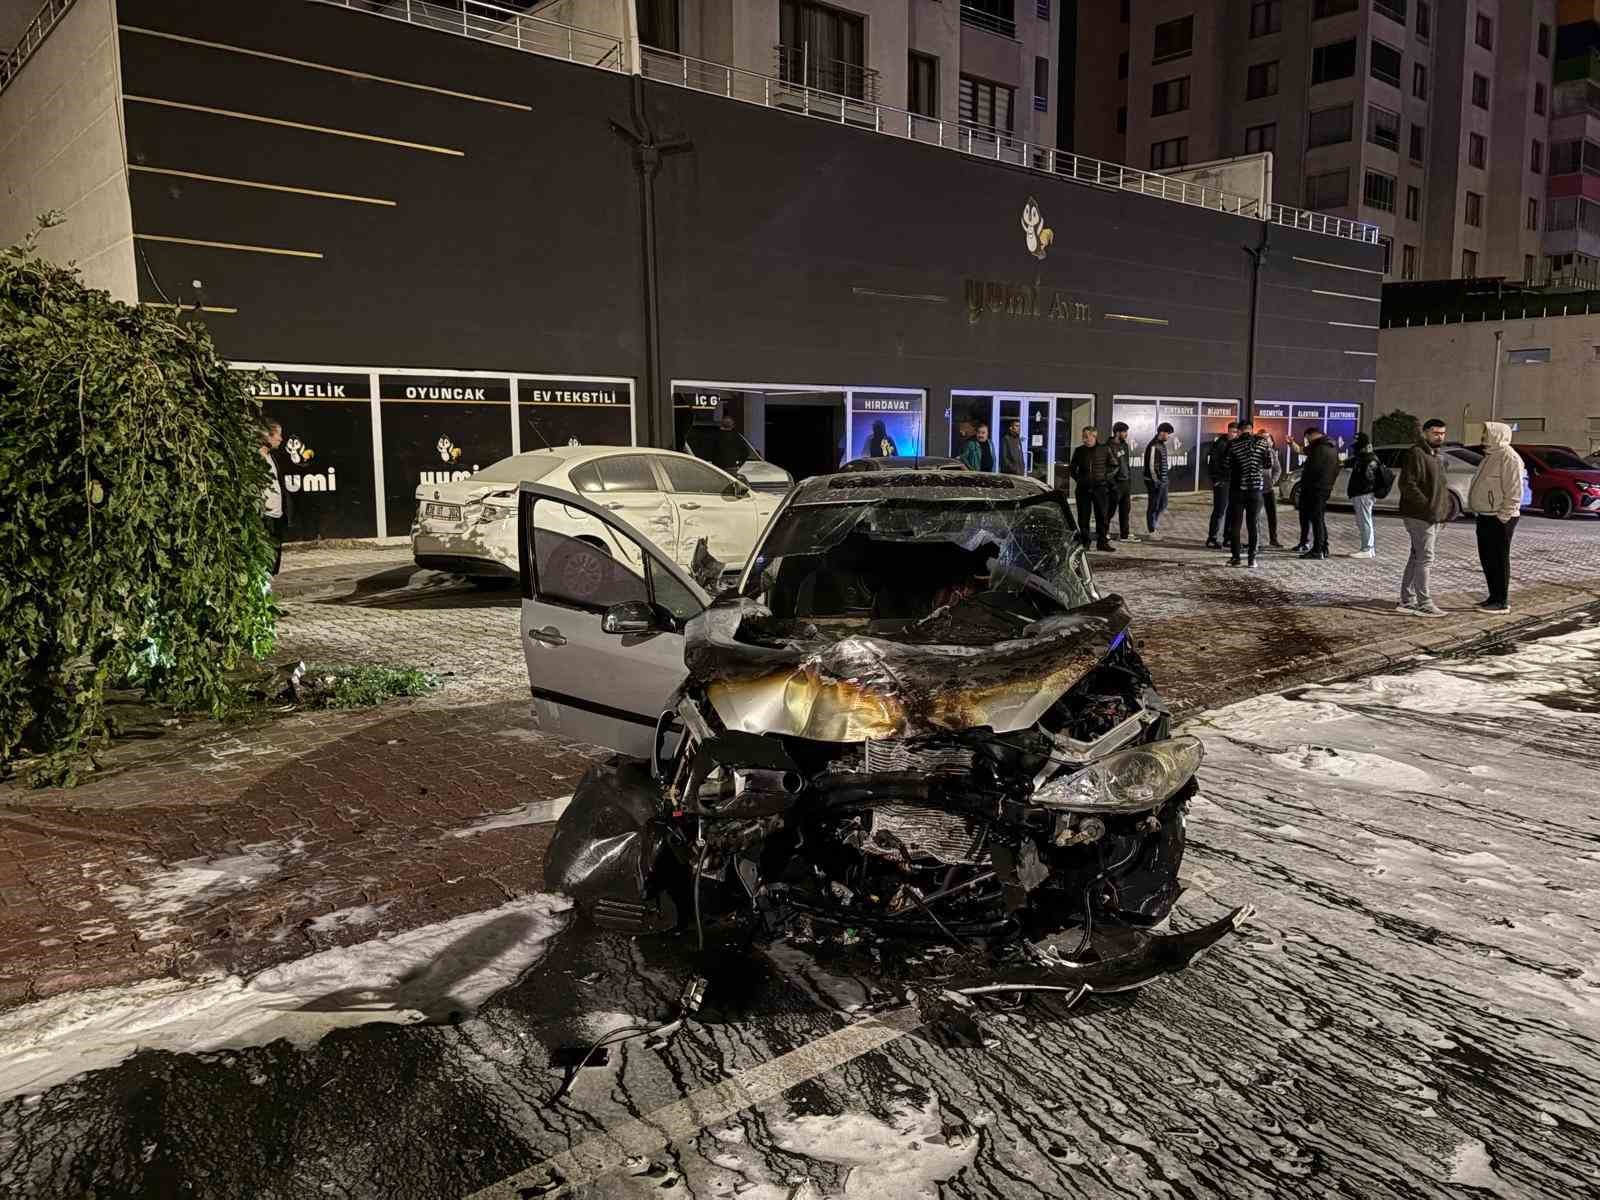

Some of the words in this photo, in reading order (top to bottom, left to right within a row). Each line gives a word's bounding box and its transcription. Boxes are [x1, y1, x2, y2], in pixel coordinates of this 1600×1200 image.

[406, 387, 486, 401] OYUNCAK
[533, 390, 553, 402] EV
[555, 389, 617, 404] TEKSTİLİ
[864, 400, 910, 411] HIRDAVAT
[284, 467, 336, 492] umi
